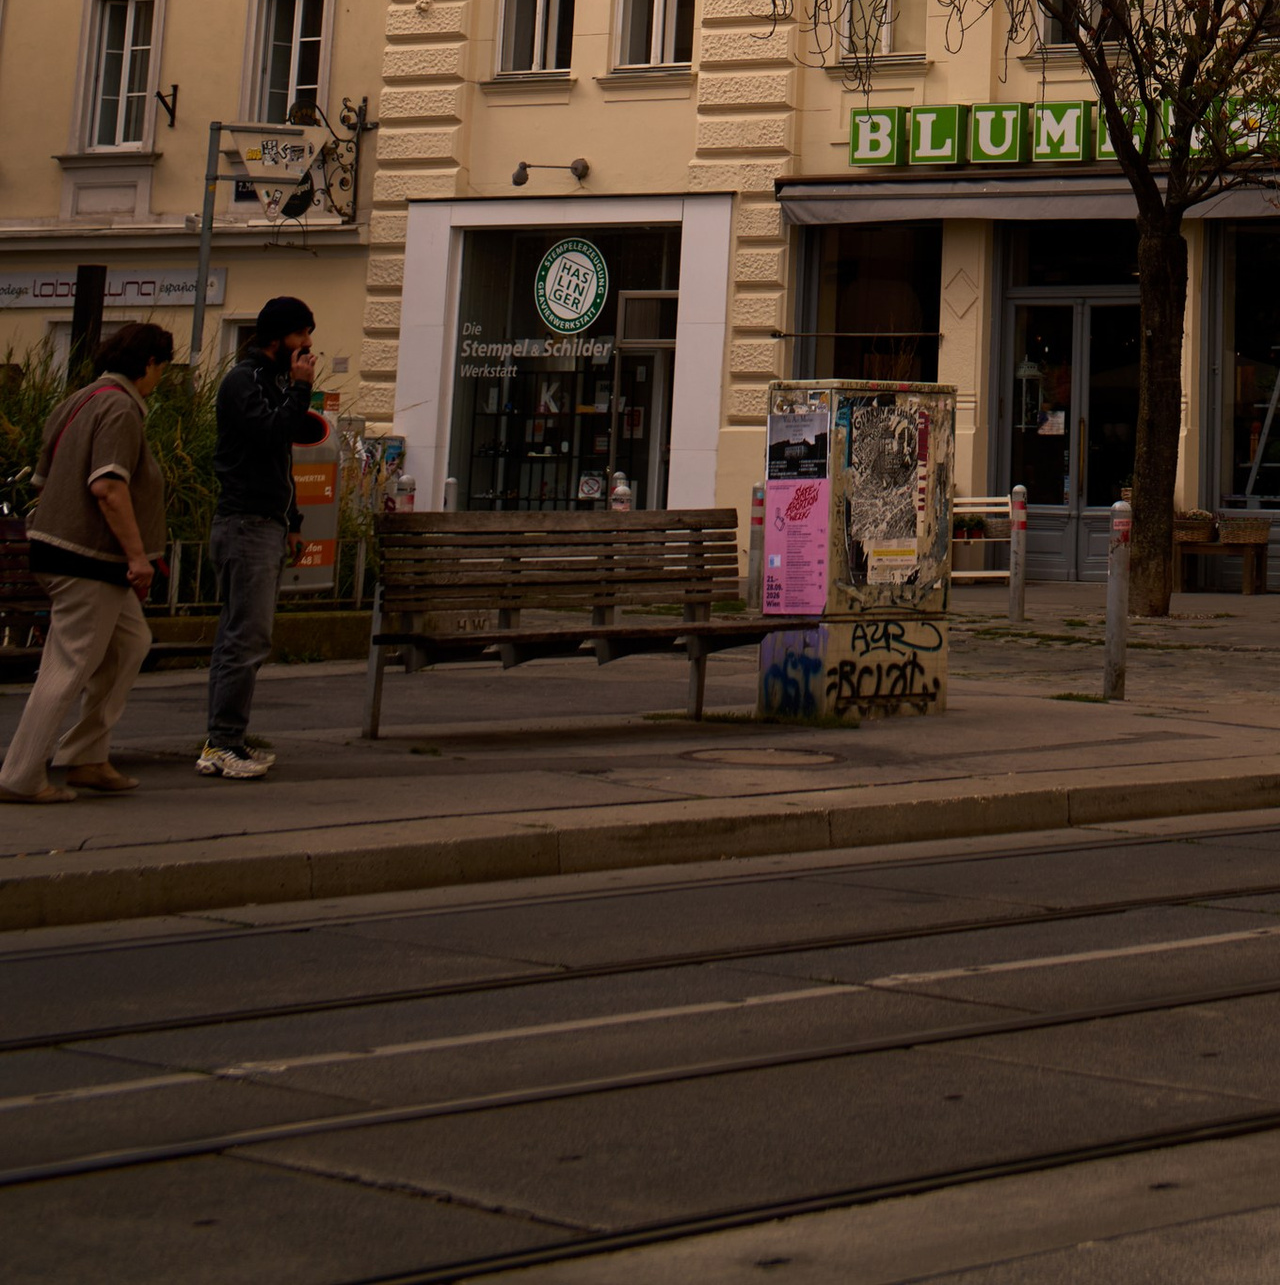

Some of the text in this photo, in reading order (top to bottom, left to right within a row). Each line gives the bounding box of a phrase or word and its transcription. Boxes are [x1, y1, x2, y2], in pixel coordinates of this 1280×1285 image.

[544, 241, 605, 294] STEMPELERZEUGUNG
[561, 262, 590, 284] HAS
[33, 279, 79, 298] lob
[104, 281, 156, 297] una
[557, 276, 585, 297] LIN
[537, 281, 597, 330] GRAVIERWERKSTATT
[553, 288, 581, 311] GER
[462, 322, 482, 336] Die
[460, 338, 612, 360] Stempel & Schilder
[460, 363, 518, 378] Werkstatt
